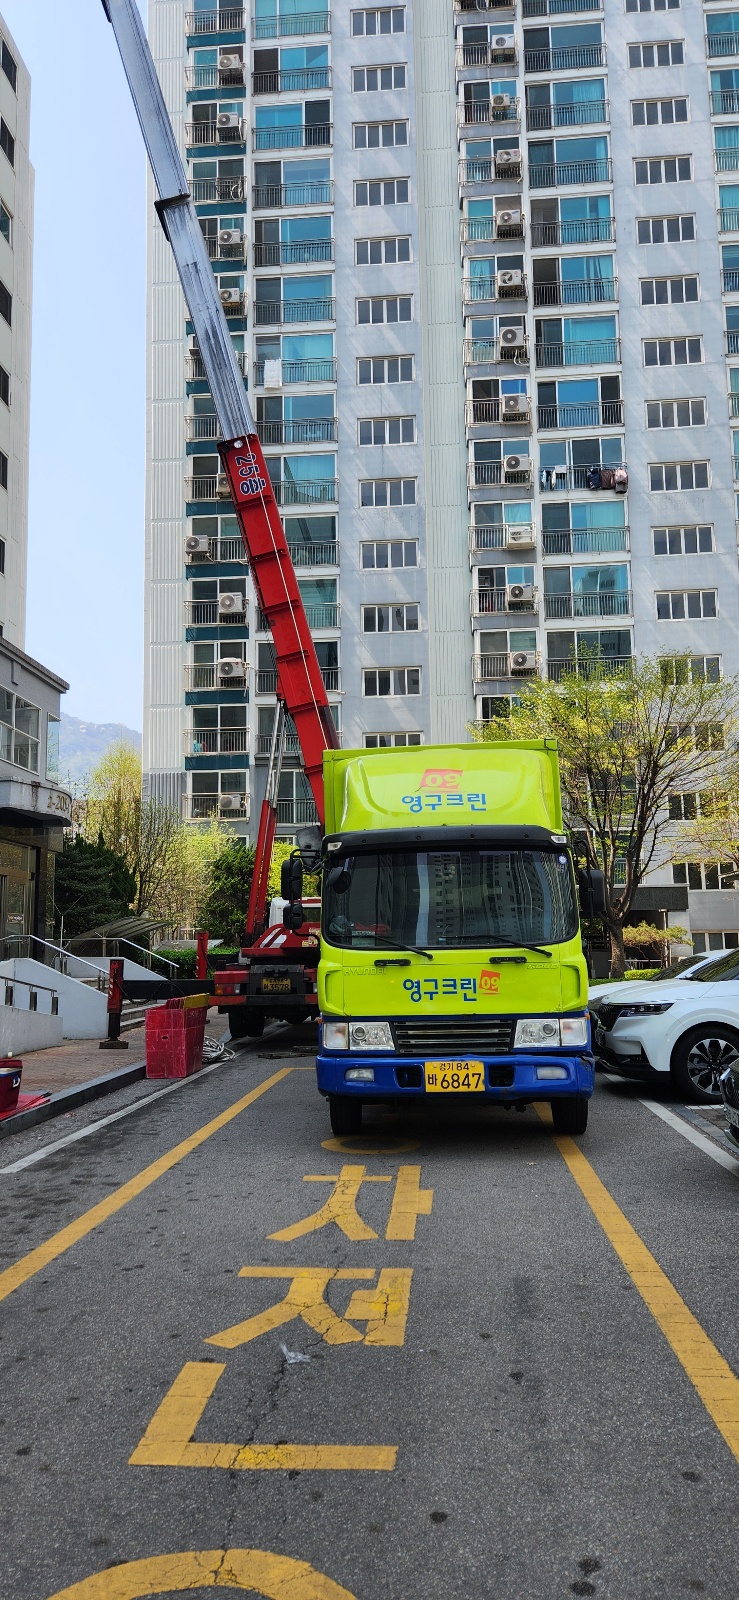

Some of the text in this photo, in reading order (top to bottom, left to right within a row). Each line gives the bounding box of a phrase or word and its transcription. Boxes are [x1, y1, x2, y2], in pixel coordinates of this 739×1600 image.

[235, 452, 266, 495] 25층
[425, 773, 462, 787] 09
[401, 793, 487, 813] 영구크린
[402, 976, 500, 1003] 영구크린 09
[439, 1062, 470, 1071] 경기 84
